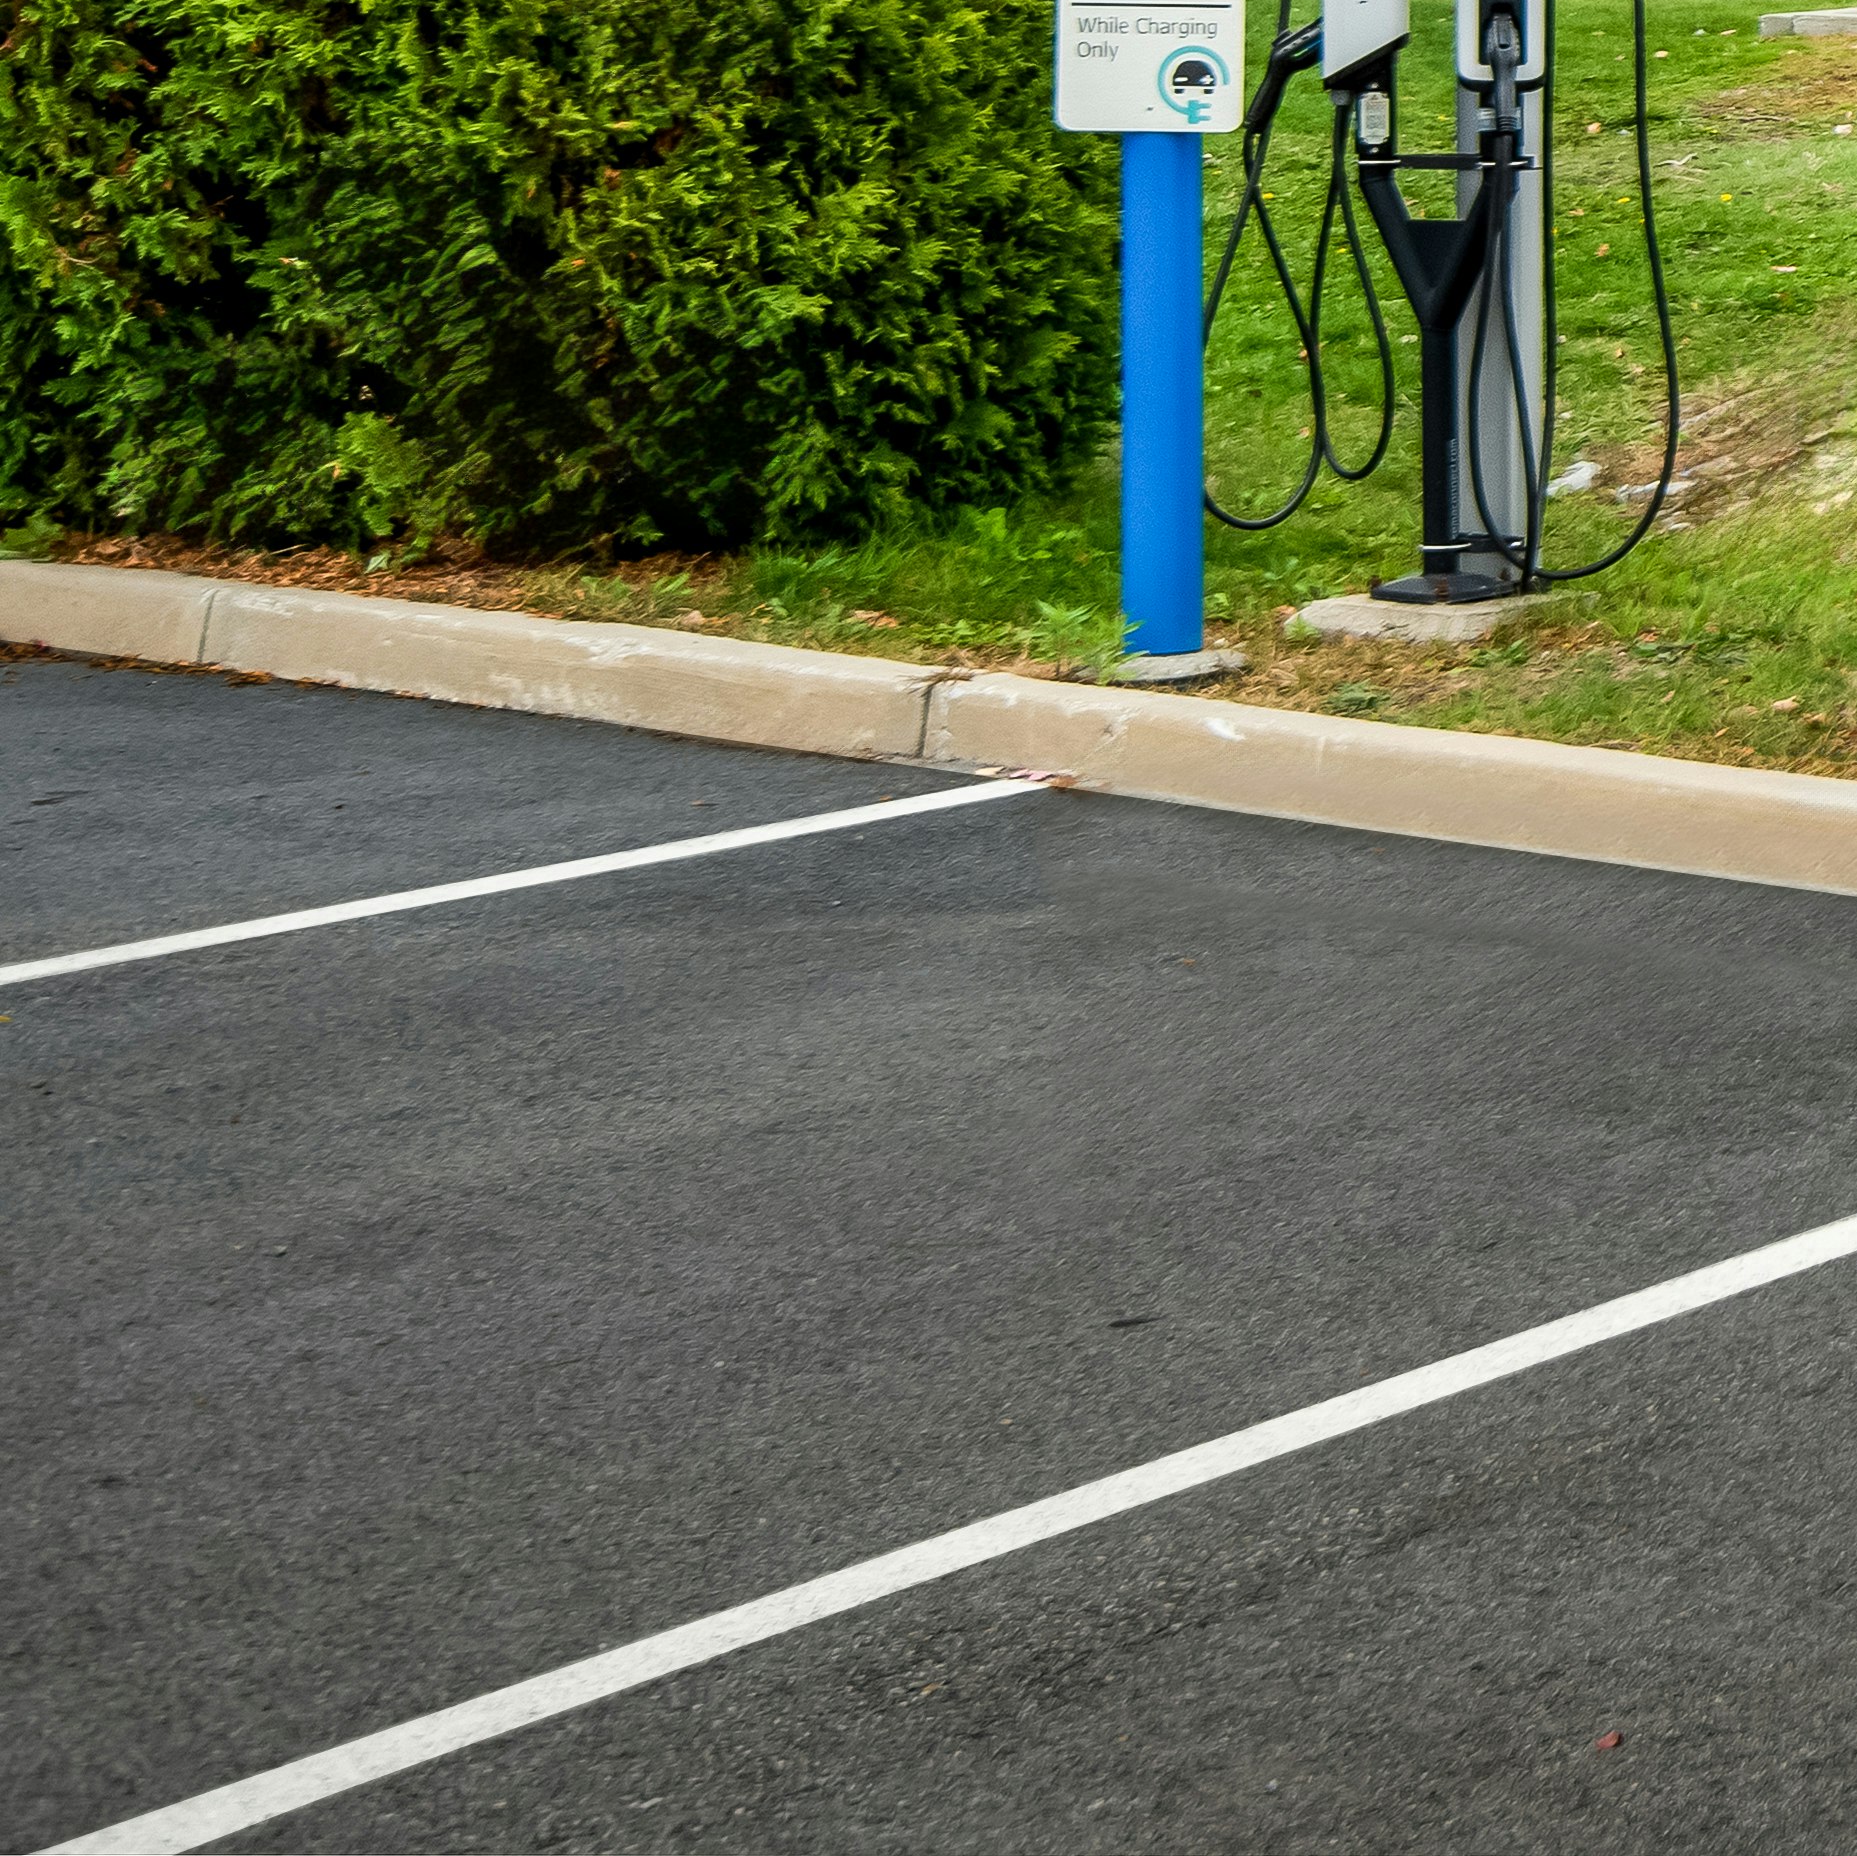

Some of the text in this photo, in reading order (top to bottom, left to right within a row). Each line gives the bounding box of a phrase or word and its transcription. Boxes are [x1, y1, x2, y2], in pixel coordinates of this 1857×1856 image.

[1077, 17, 1217, 39] While Charging
[1077, 41, 1118, 62] Only
